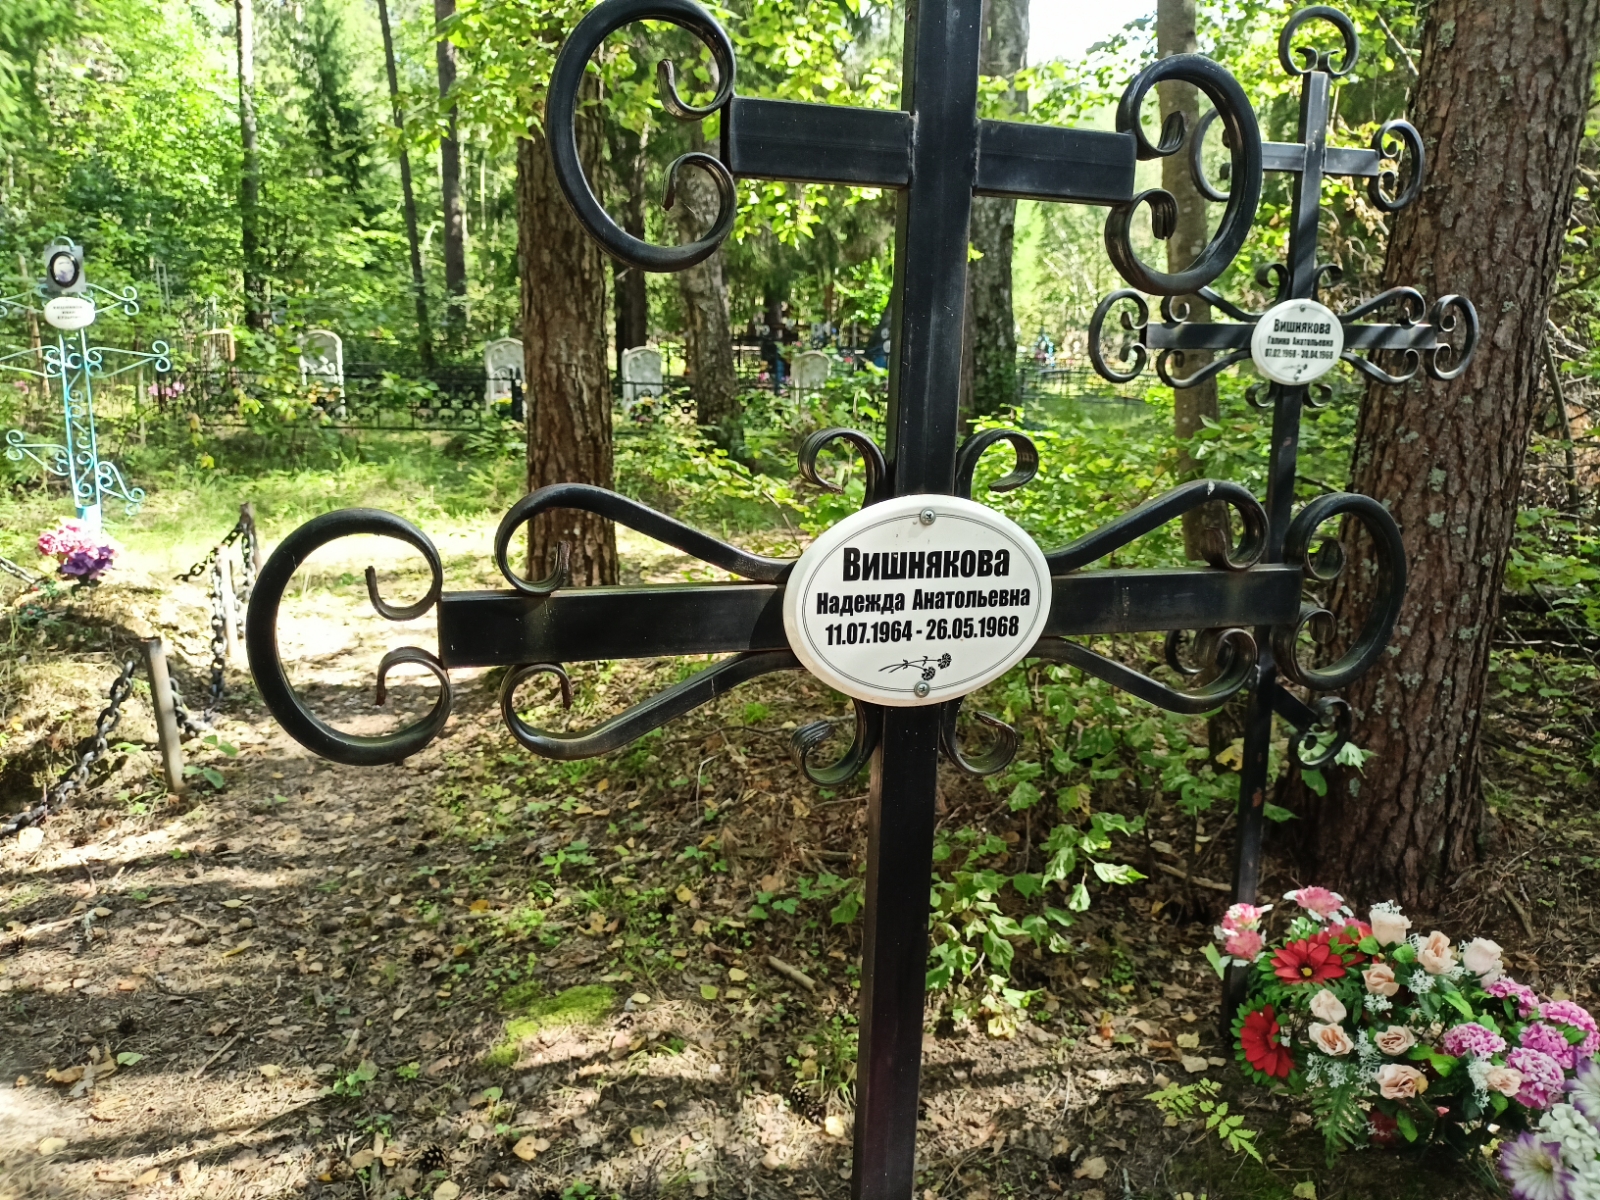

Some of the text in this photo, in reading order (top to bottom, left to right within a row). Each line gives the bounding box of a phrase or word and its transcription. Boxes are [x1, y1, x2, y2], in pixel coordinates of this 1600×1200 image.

[1273, 318, 1331, 335] Вишнякова
[842, 547, 1010, 581] Вишнякова
[816, 588, 1031, 617] Надежда Анатольевна
[825, 620, 912, 646] 11.07.1964
[926, 615, 1019, 641] 26.05.1968
